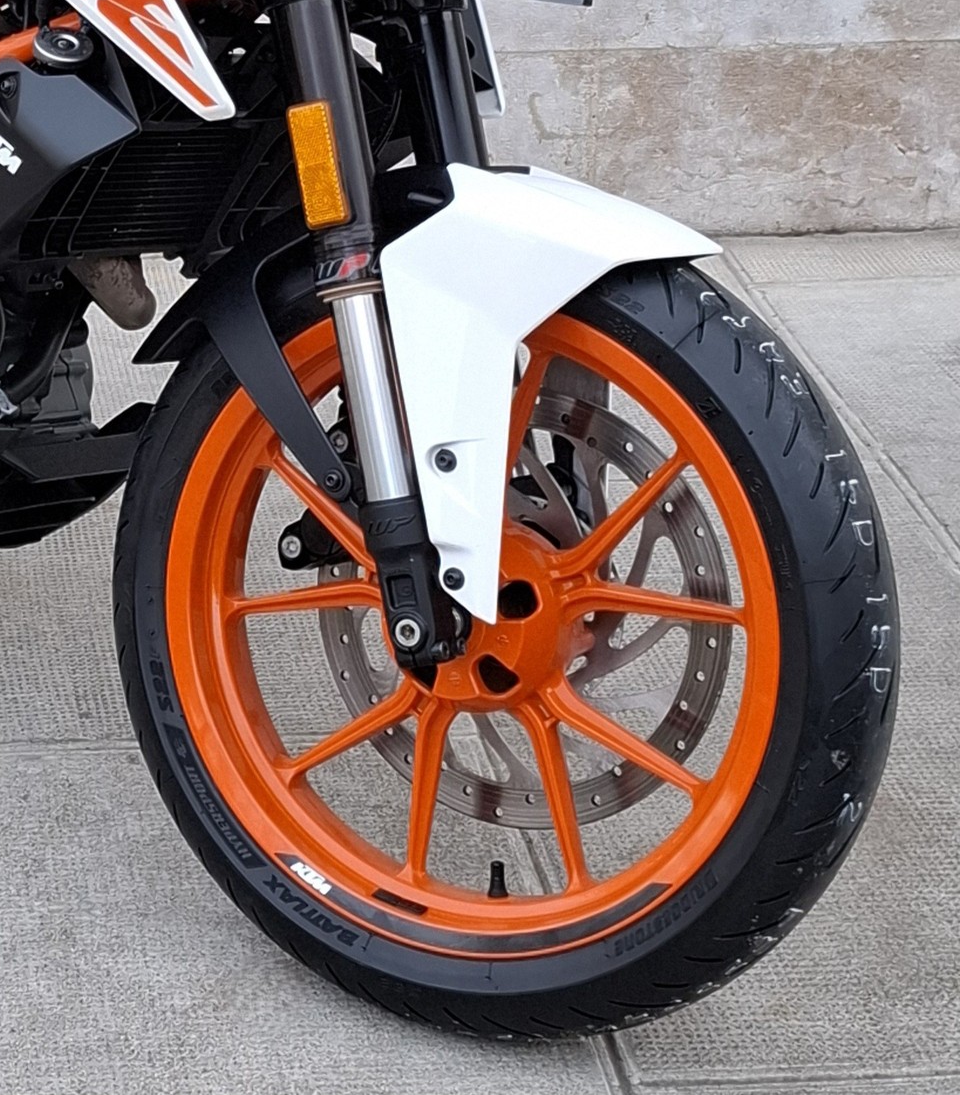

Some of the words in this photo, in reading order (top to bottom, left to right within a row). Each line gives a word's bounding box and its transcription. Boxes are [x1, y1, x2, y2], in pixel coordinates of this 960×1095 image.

[184, 765, 251, 860] HYPERSPORT
[262, 875, 361, 948] BATTLAX
[290, 861, 332, 895] KTM
